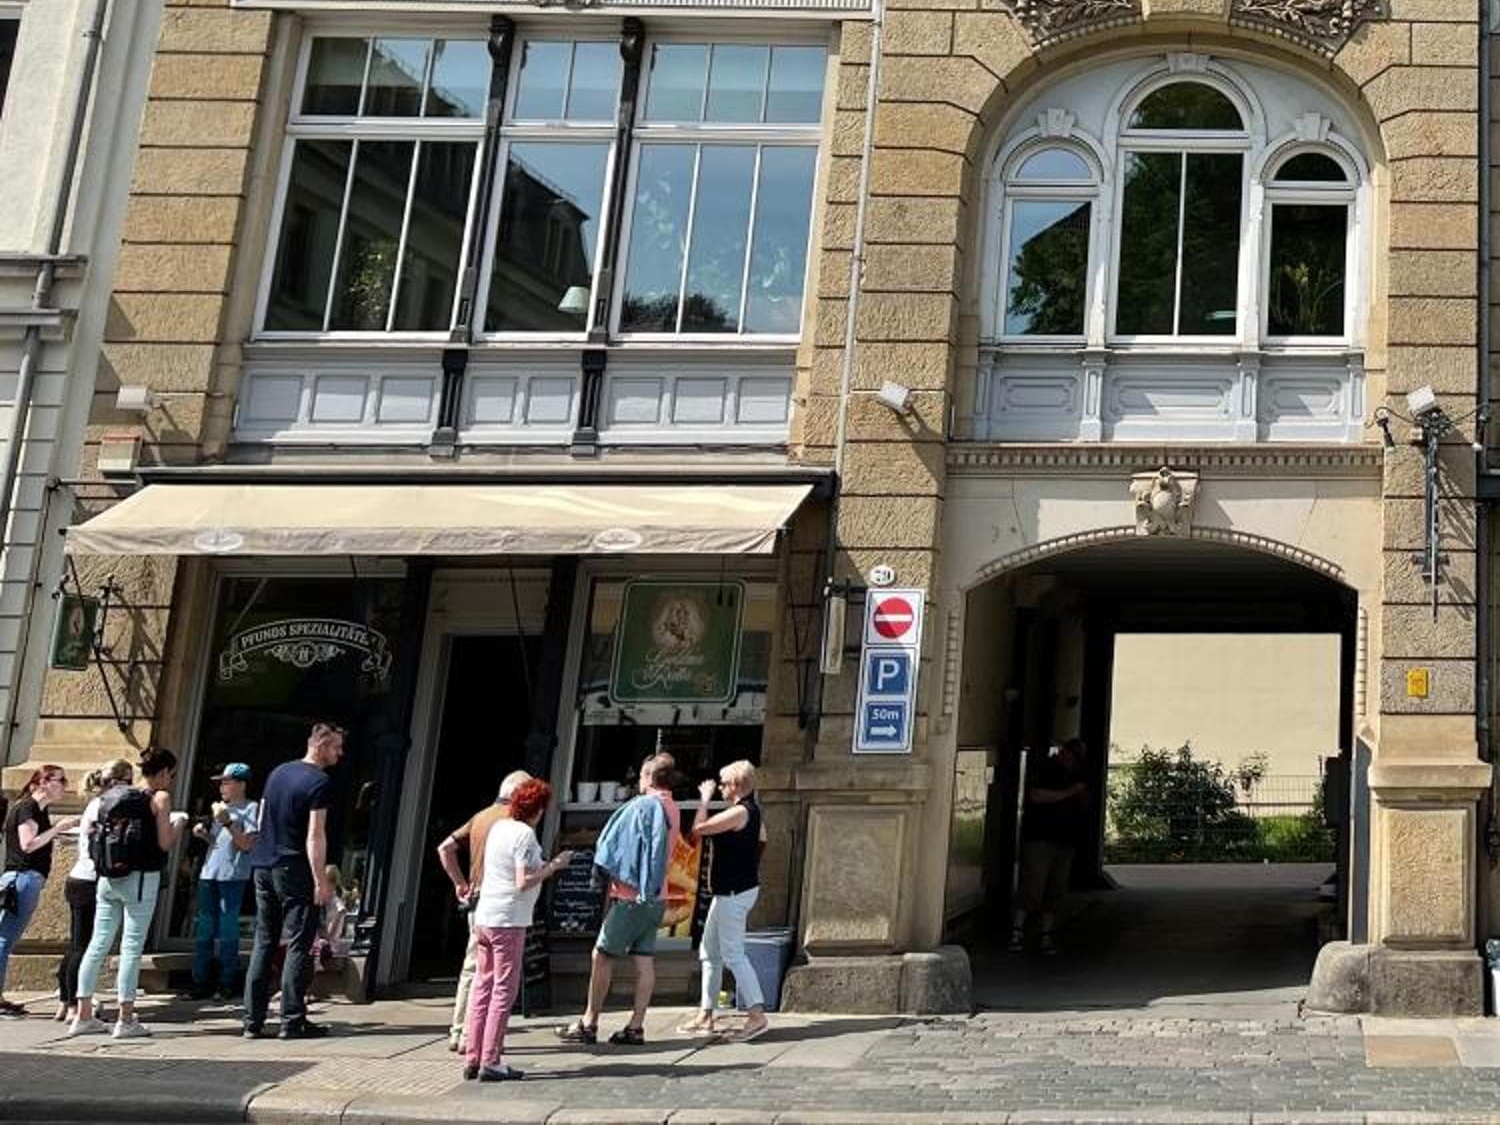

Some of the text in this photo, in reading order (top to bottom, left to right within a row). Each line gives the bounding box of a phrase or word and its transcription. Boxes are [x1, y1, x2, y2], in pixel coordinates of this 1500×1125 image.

[241, 625, 287, 648] PFUNDS
[877, 658, 900, 690] P
[871, 708, 899, 721] 50m
